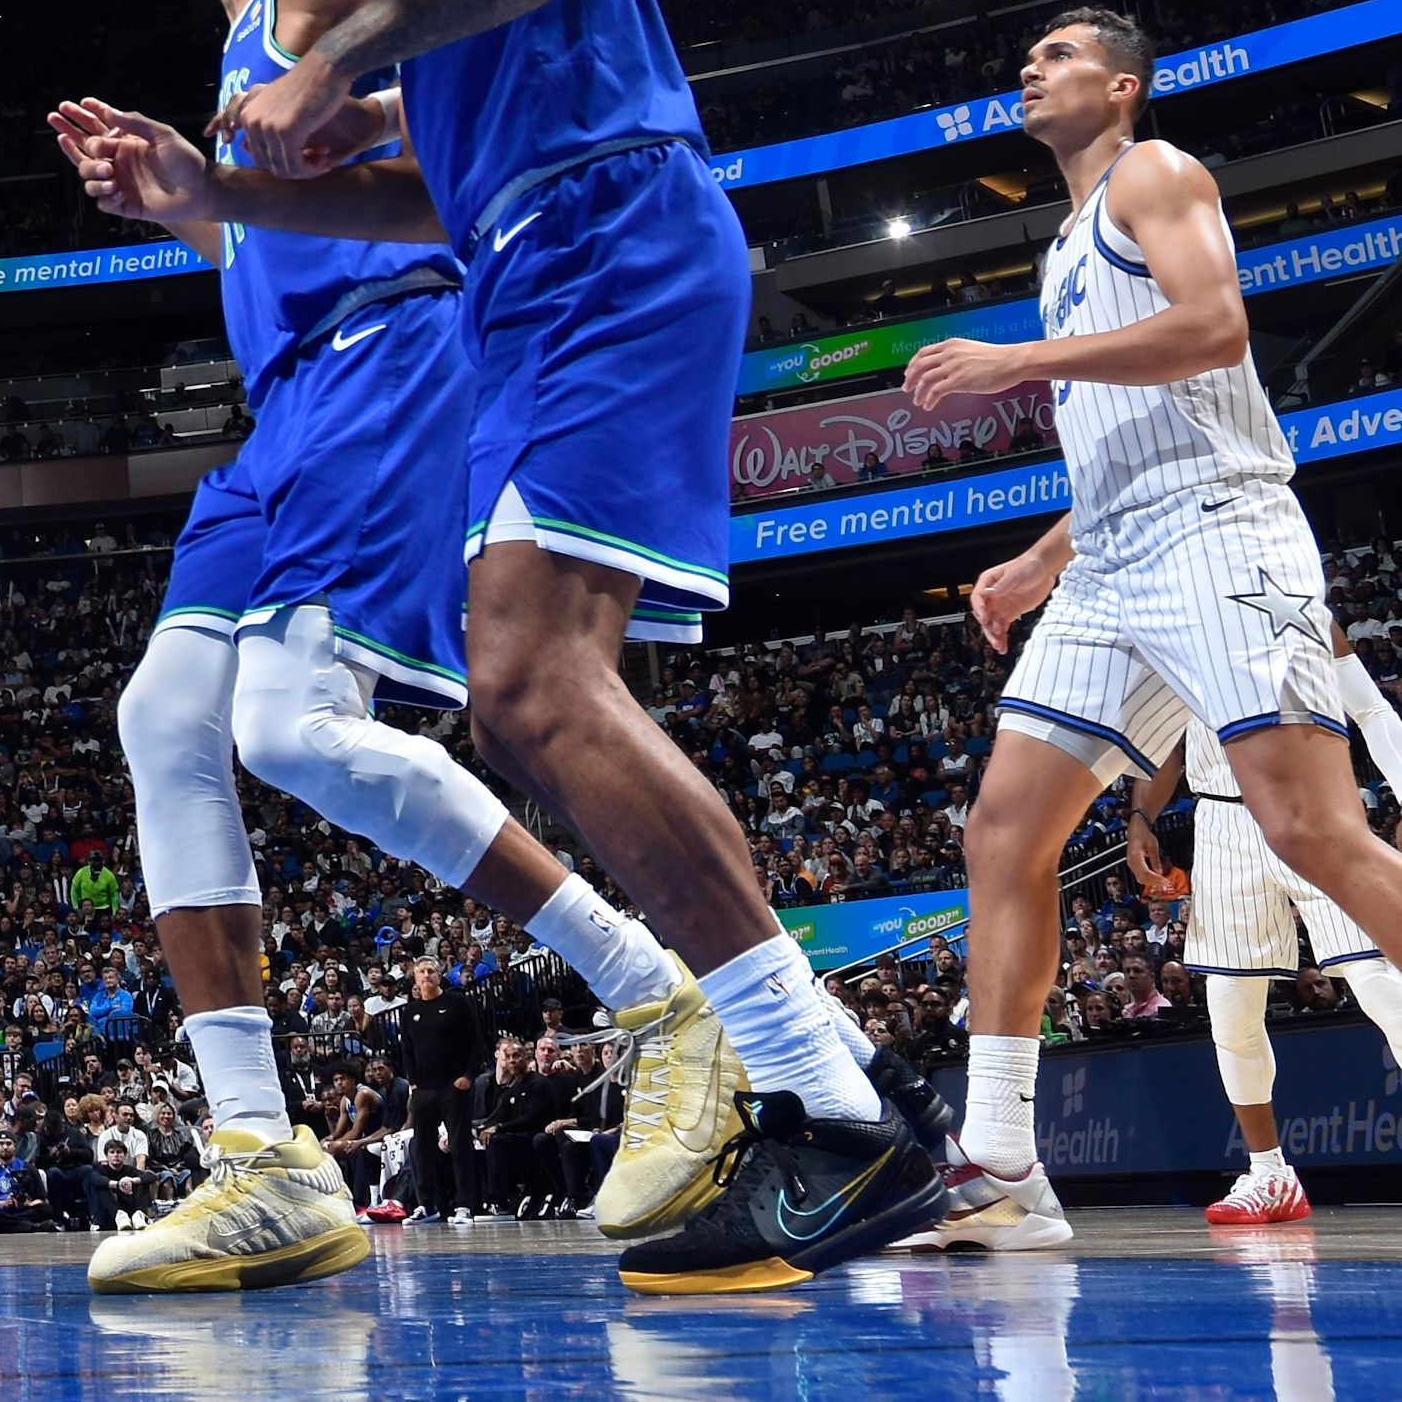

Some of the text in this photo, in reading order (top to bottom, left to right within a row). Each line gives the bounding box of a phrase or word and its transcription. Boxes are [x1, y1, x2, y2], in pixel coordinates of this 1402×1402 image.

[1152, 44, 1249, 92] ealth
[15, 255, 102, 282] mental
[109, 246, 189, 273] health
[756, 470, 1070, 548] Free mental health
[907, 910, 959, 935] GOOD?”
